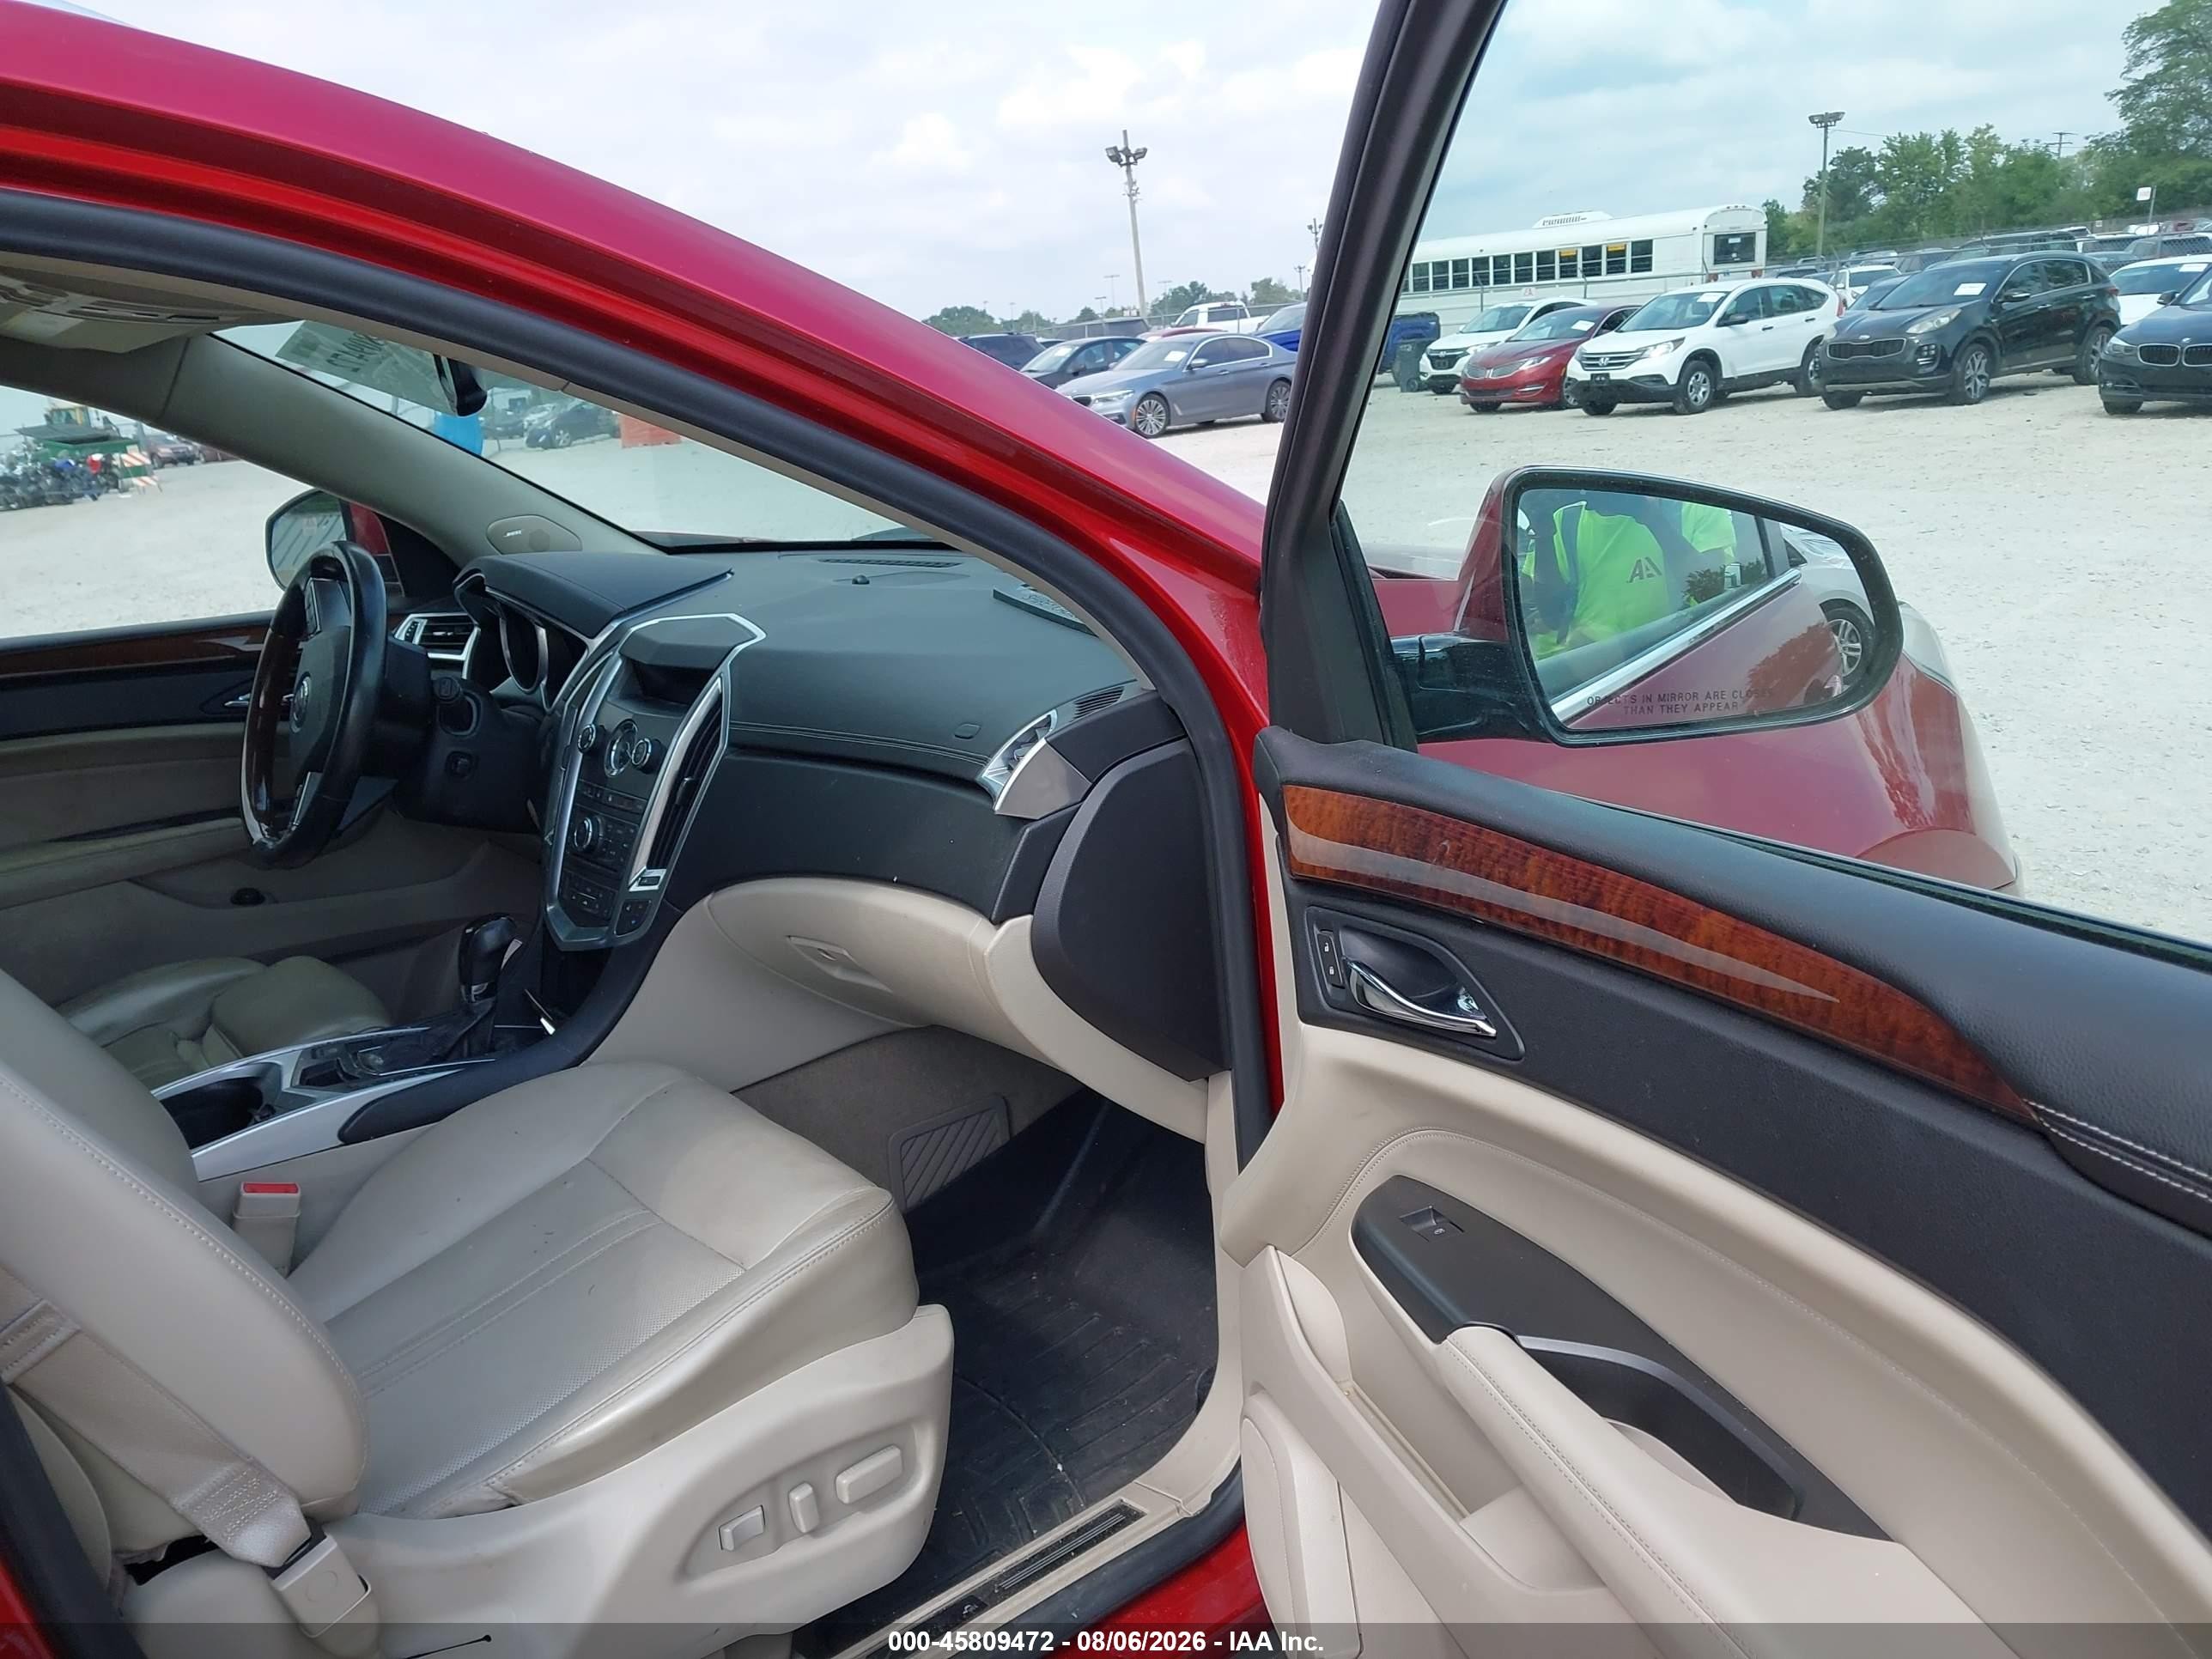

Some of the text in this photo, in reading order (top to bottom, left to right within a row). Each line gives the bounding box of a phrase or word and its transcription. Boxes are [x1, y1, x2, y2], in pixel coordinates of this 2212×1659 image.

[1587, 687, 1771, 706] OBECTS IN MIRROR ARE CLOS
[1624, 702, 1738, 715] THAN THEY APPEAR
